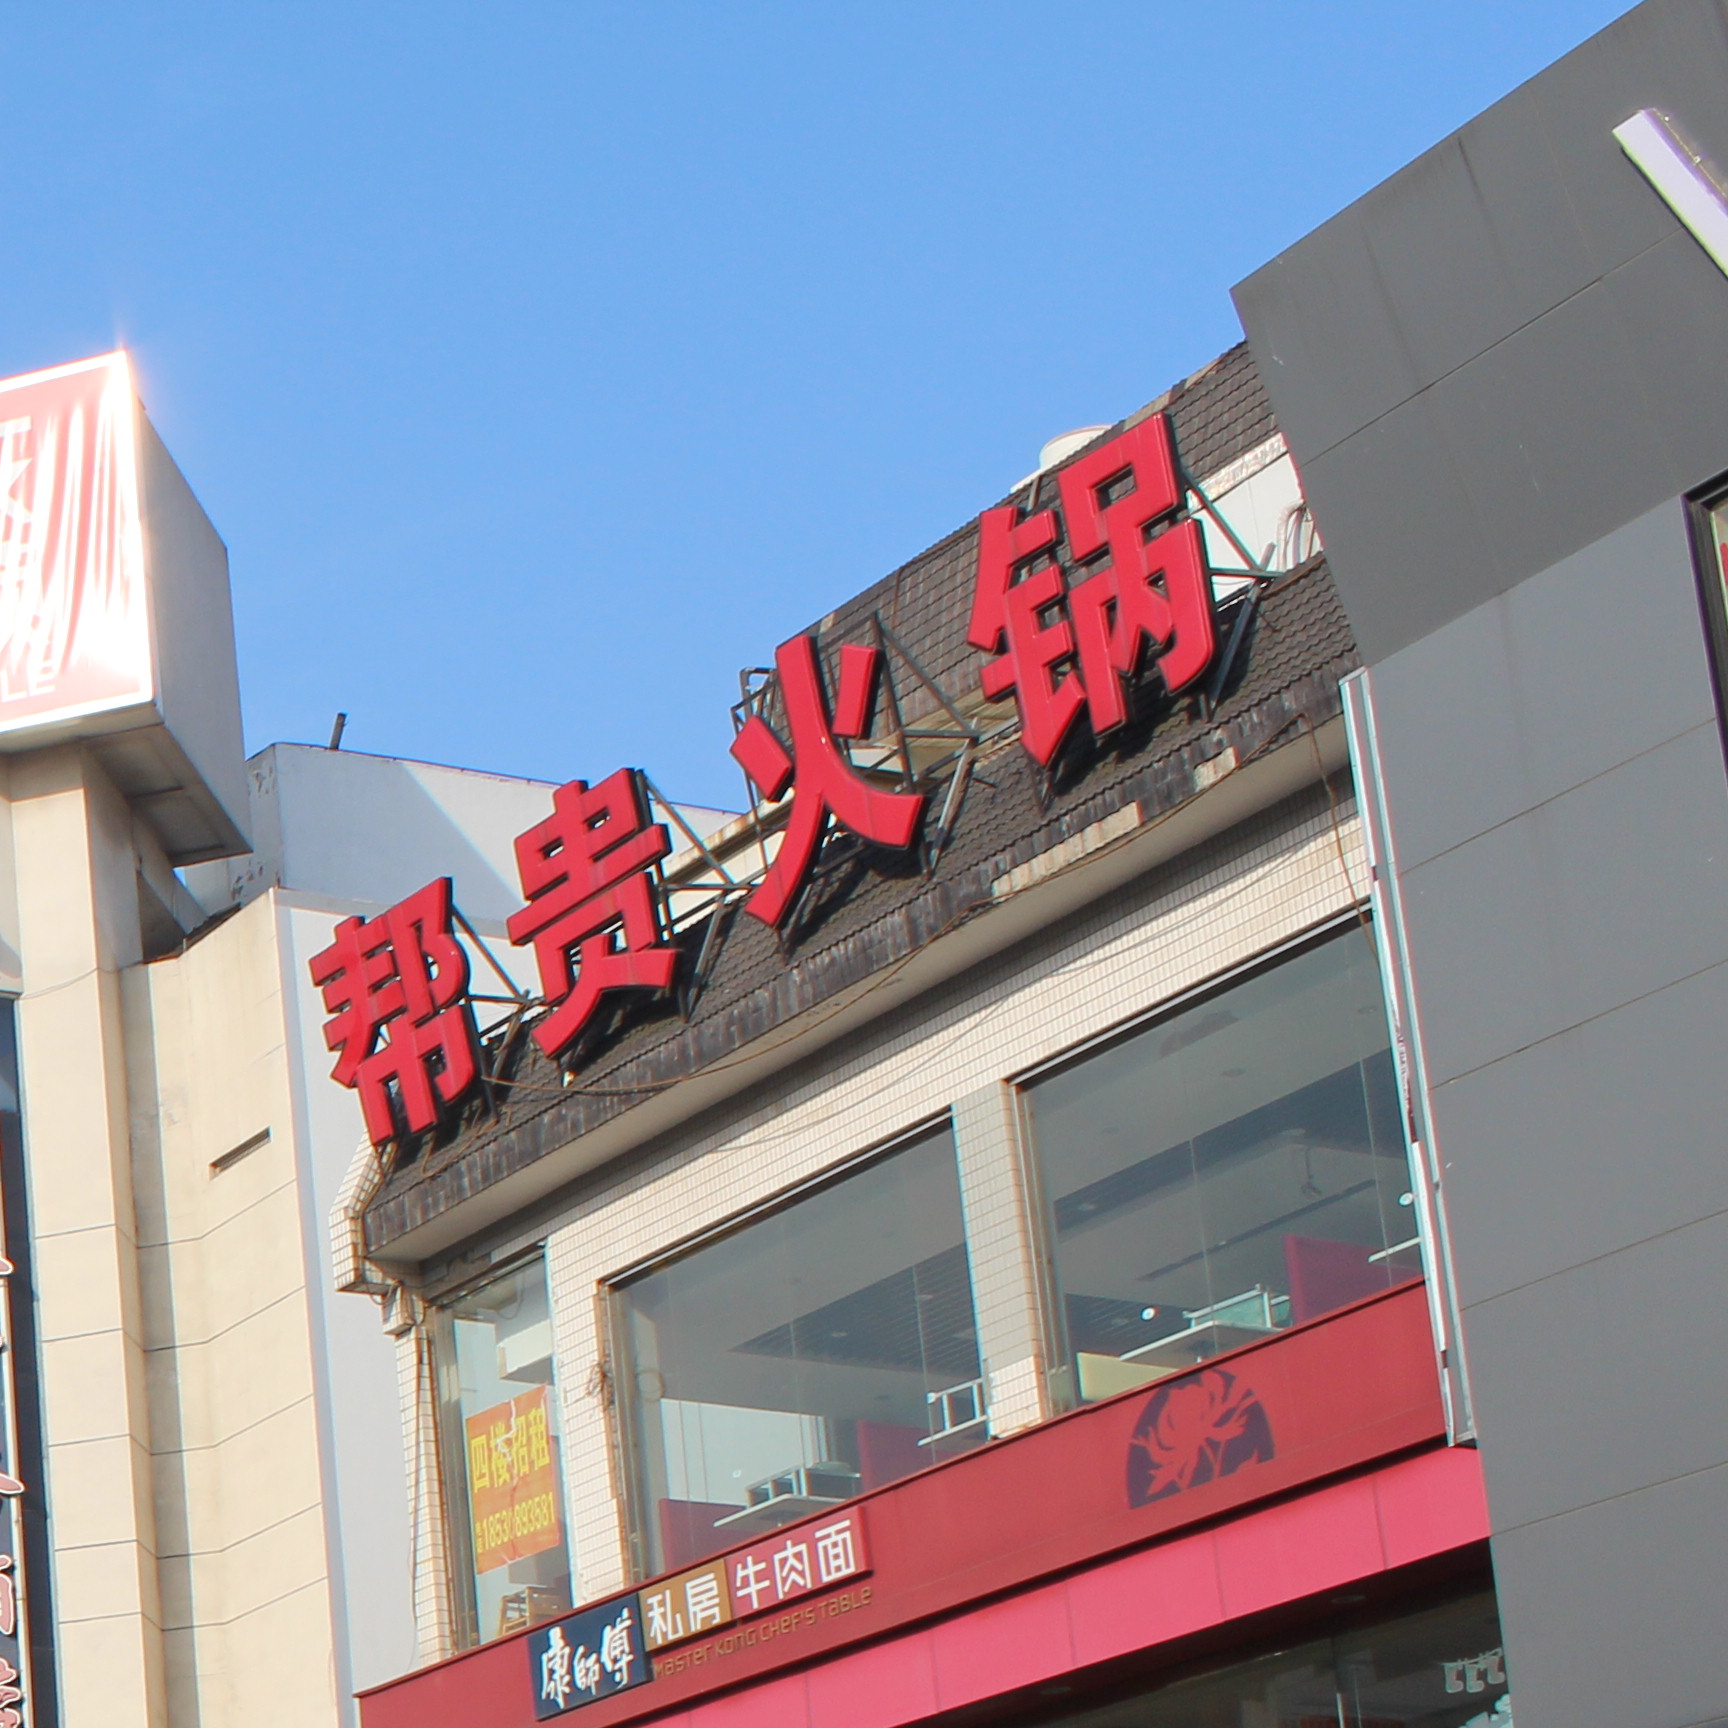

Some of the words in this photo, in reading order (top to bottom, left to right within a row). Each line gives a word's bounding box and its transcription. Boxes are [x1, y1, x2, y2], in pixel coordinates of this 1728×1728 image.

[309, 411, 1218, 1145] 帮贵火锅
[470, 1407, 550, 1493] 四楼招租
[647, 1572, 721, 1645] 私房
[736, 1519, 856, 1610] 牛肉面
